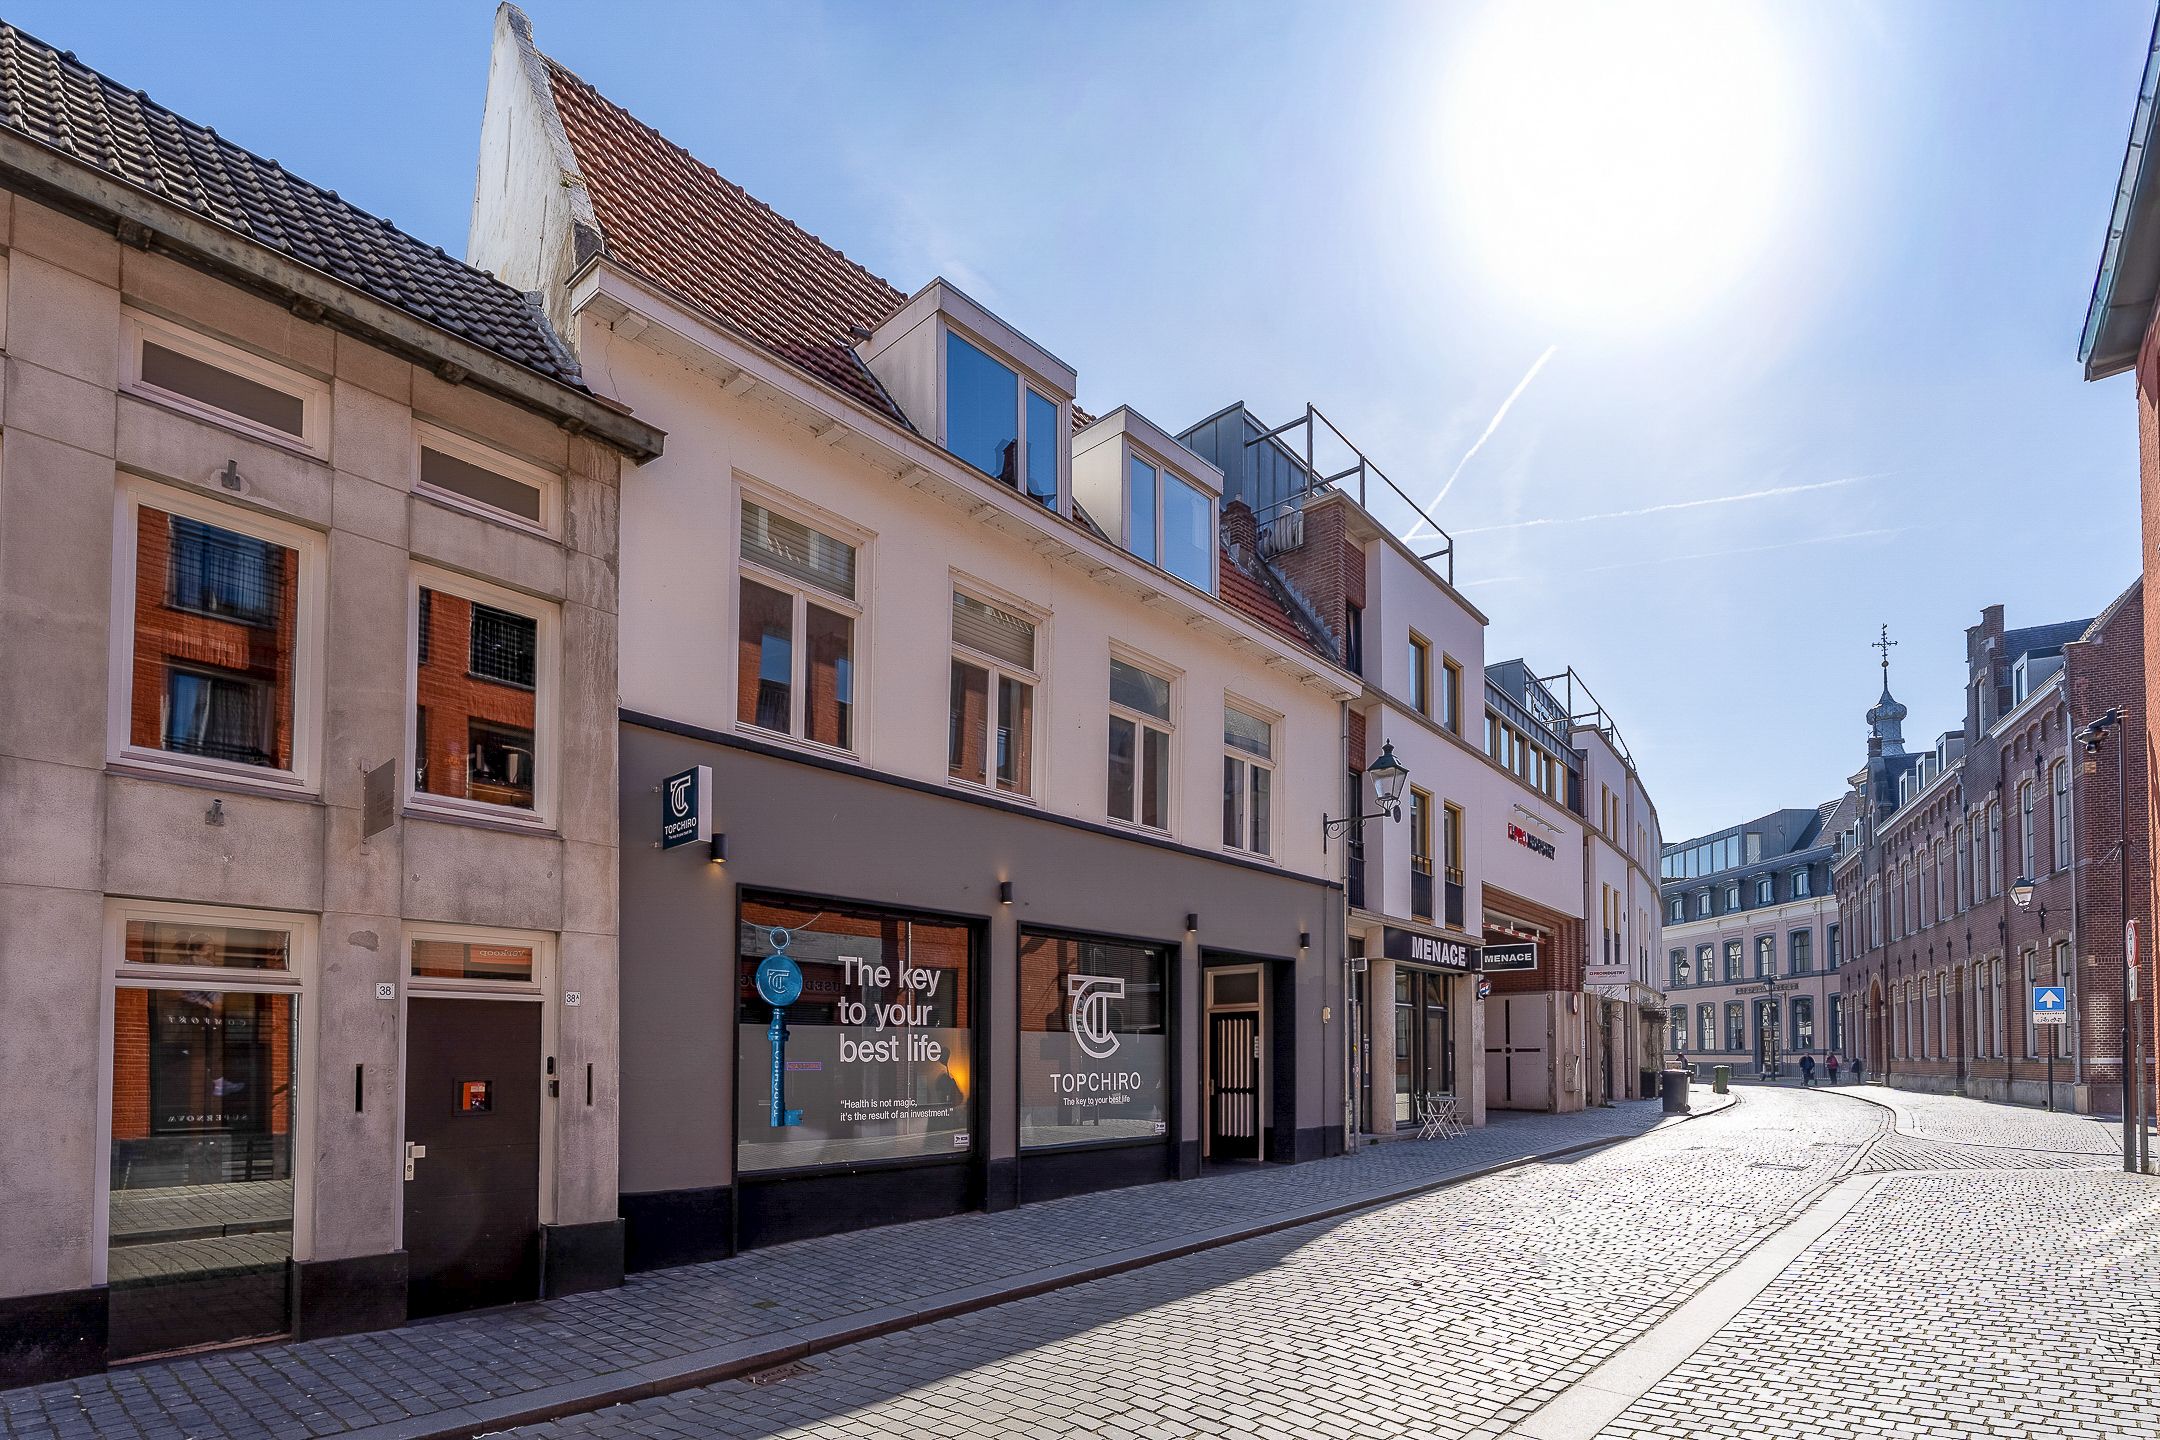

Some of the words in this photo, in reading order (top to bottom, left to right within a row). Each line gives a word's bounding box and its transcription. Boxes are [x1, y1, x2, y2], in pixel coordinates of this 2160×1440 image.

[664, 817, 697, 835] TOPCHIRO
[1411, 936, 1466, 967] MENACE
[1484, 952, 1532, 963] MENACE
[838, 955, 891, 988] The
[899, 960, 941, 997] key
[379, 986, 392, 996] 38
[837, 996, 867, 1025] to
[874, 1003, 933, 1032] your
[840, 1033, 900, 1063] best
[907, 1034, 942, 1062] life
[1050, 1071, 1141, 1093] TOPCHIRO
[871, 1098, 878, 1108] is
[879, 1098, 892, 1108] not
[893, 1097, 918, 1109] magic,
[1063, 1097, 1075, 1106] The
[1075, 1096, 1086, 1107] key
[1087, 1096, 1094, 1105] to
[1094, 1097, 1108, 1106] your
[1108, 1095, 1121, 1104] best
[1121, 1094, 1131, 1103] life
[840, 1112, 853, 1122] it's
[854, 1111, 867, 1121] the
[868, 1110, 890, 1120] result
[891, 1109, 899, 1119] of
[899, 1111, 909, 1119] an
